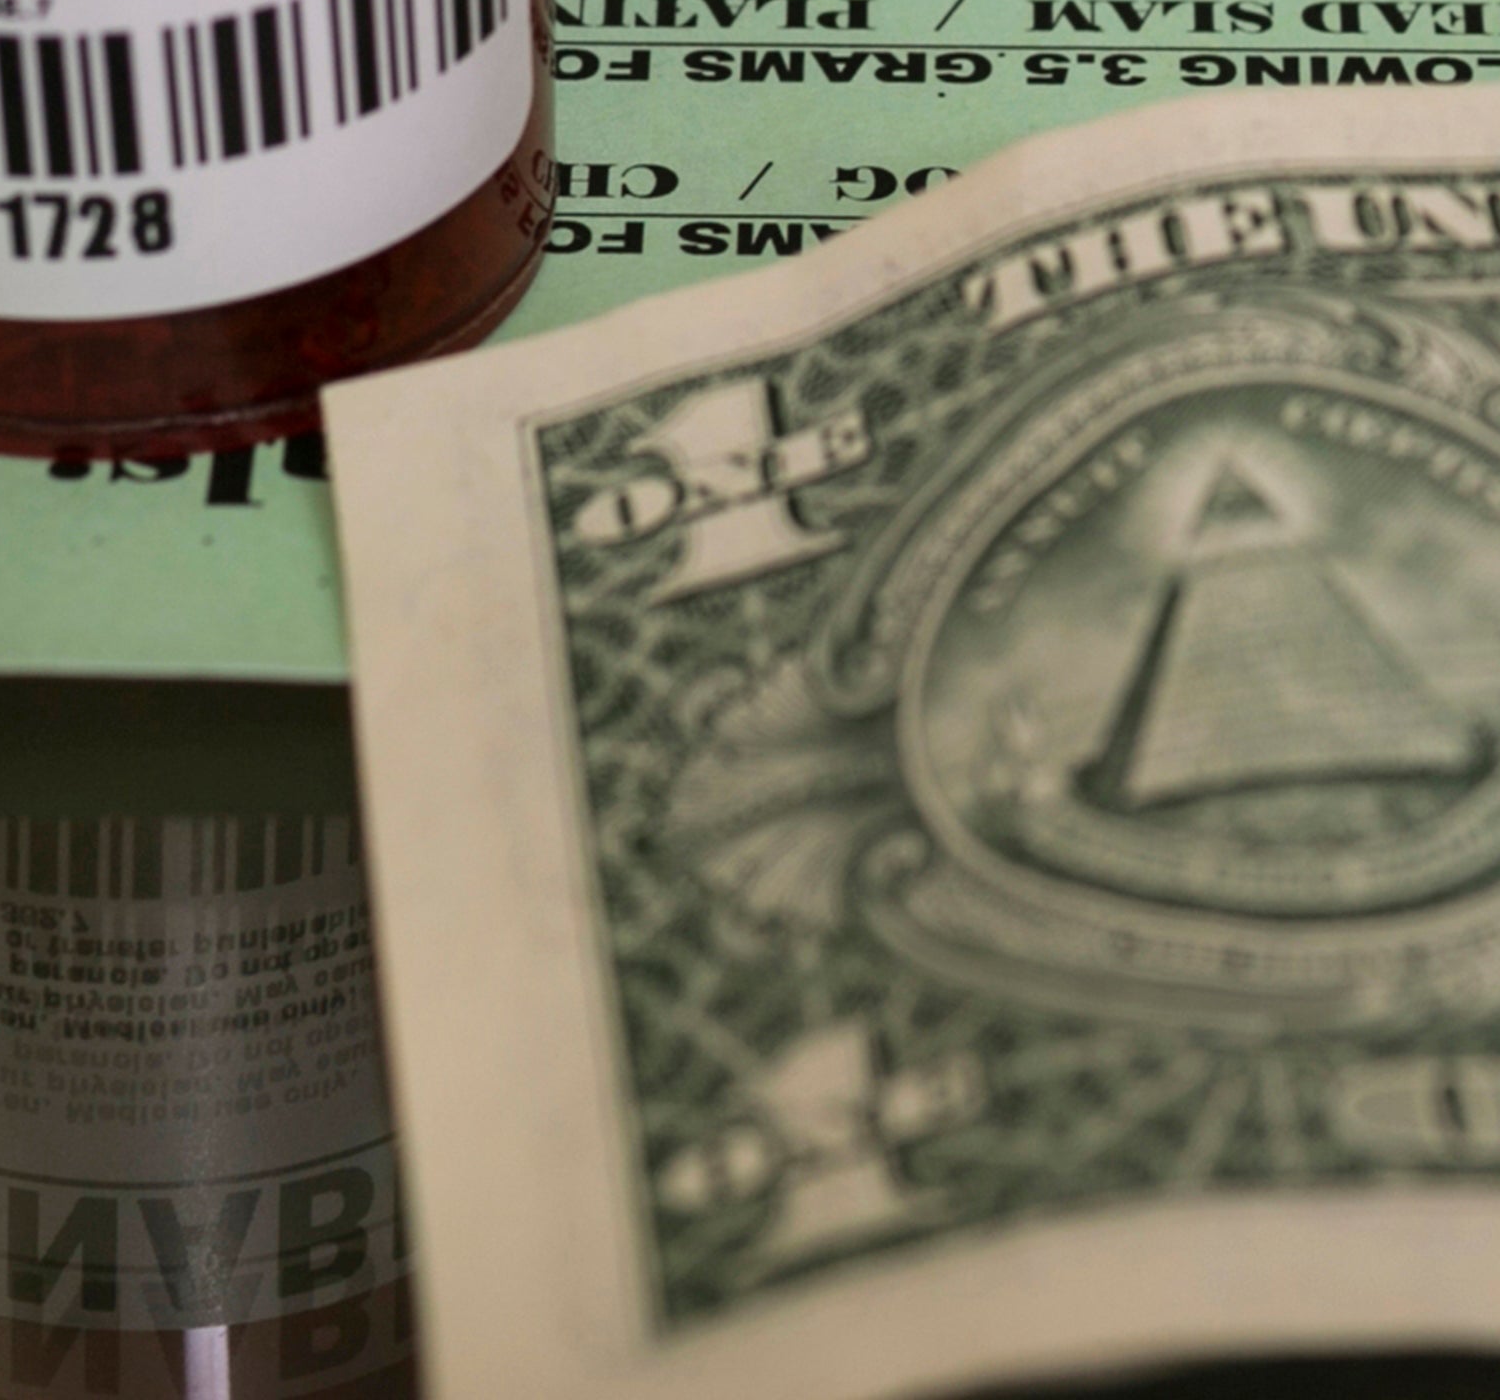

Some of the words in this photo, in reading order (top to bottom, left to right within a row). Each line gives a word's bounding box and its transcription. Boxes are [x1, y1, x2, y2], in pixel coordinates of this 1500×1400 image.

[682, 47, 996, 85] GRAMS
[1024, 51, 1149, 86] 3.5
[962, 186, 1299, 330] THE
